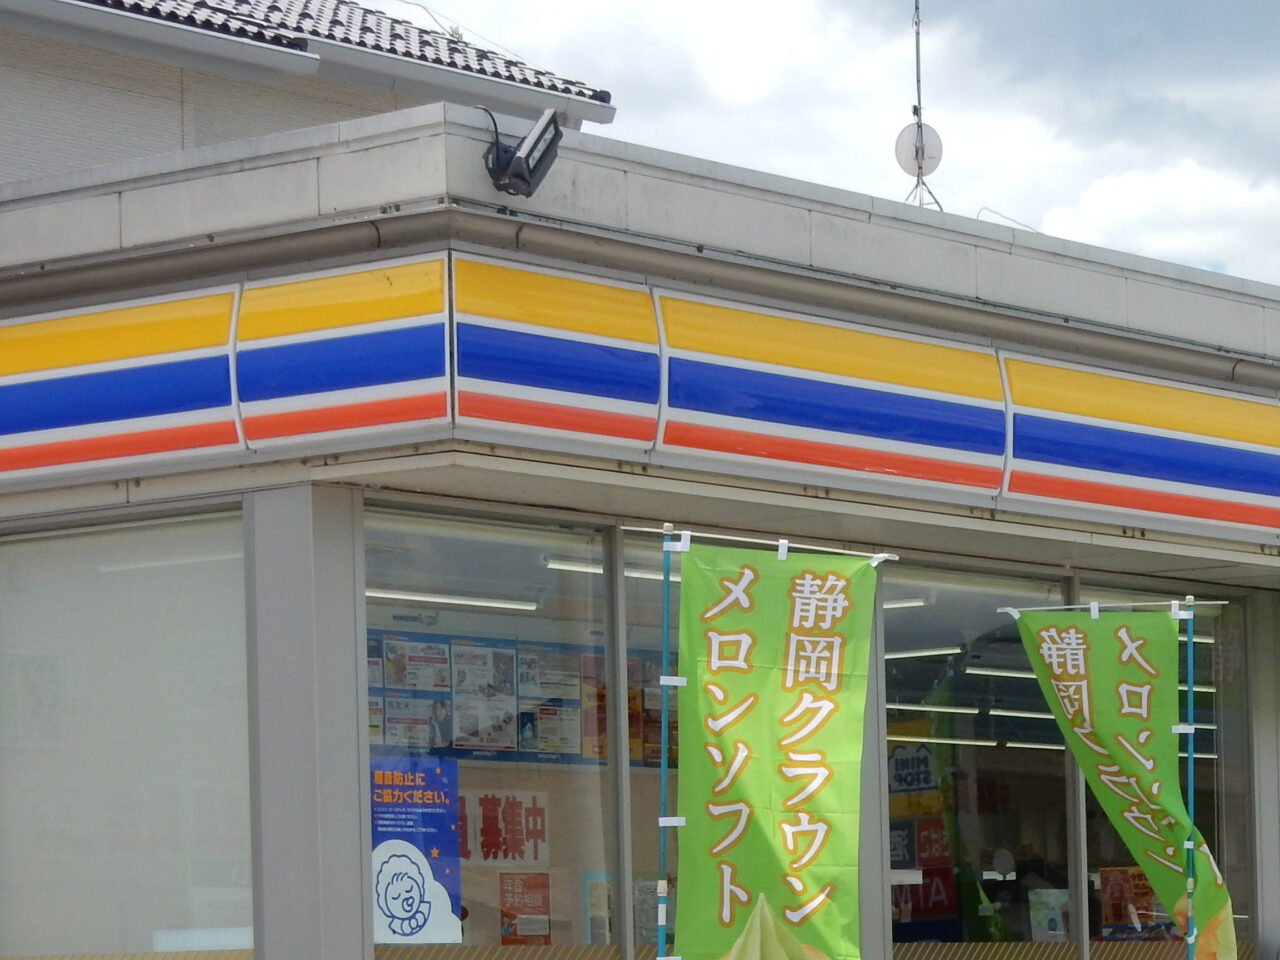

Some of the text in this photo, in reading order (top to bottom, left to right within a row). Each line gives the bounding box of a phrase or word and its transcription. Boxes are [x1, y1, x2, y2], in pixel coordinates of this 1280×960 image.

[479, 794, 546, 861] 募集中
[703, 567, 756, 925] メロンソフト
[781, 571, 849, 924] 静岡クラウン
